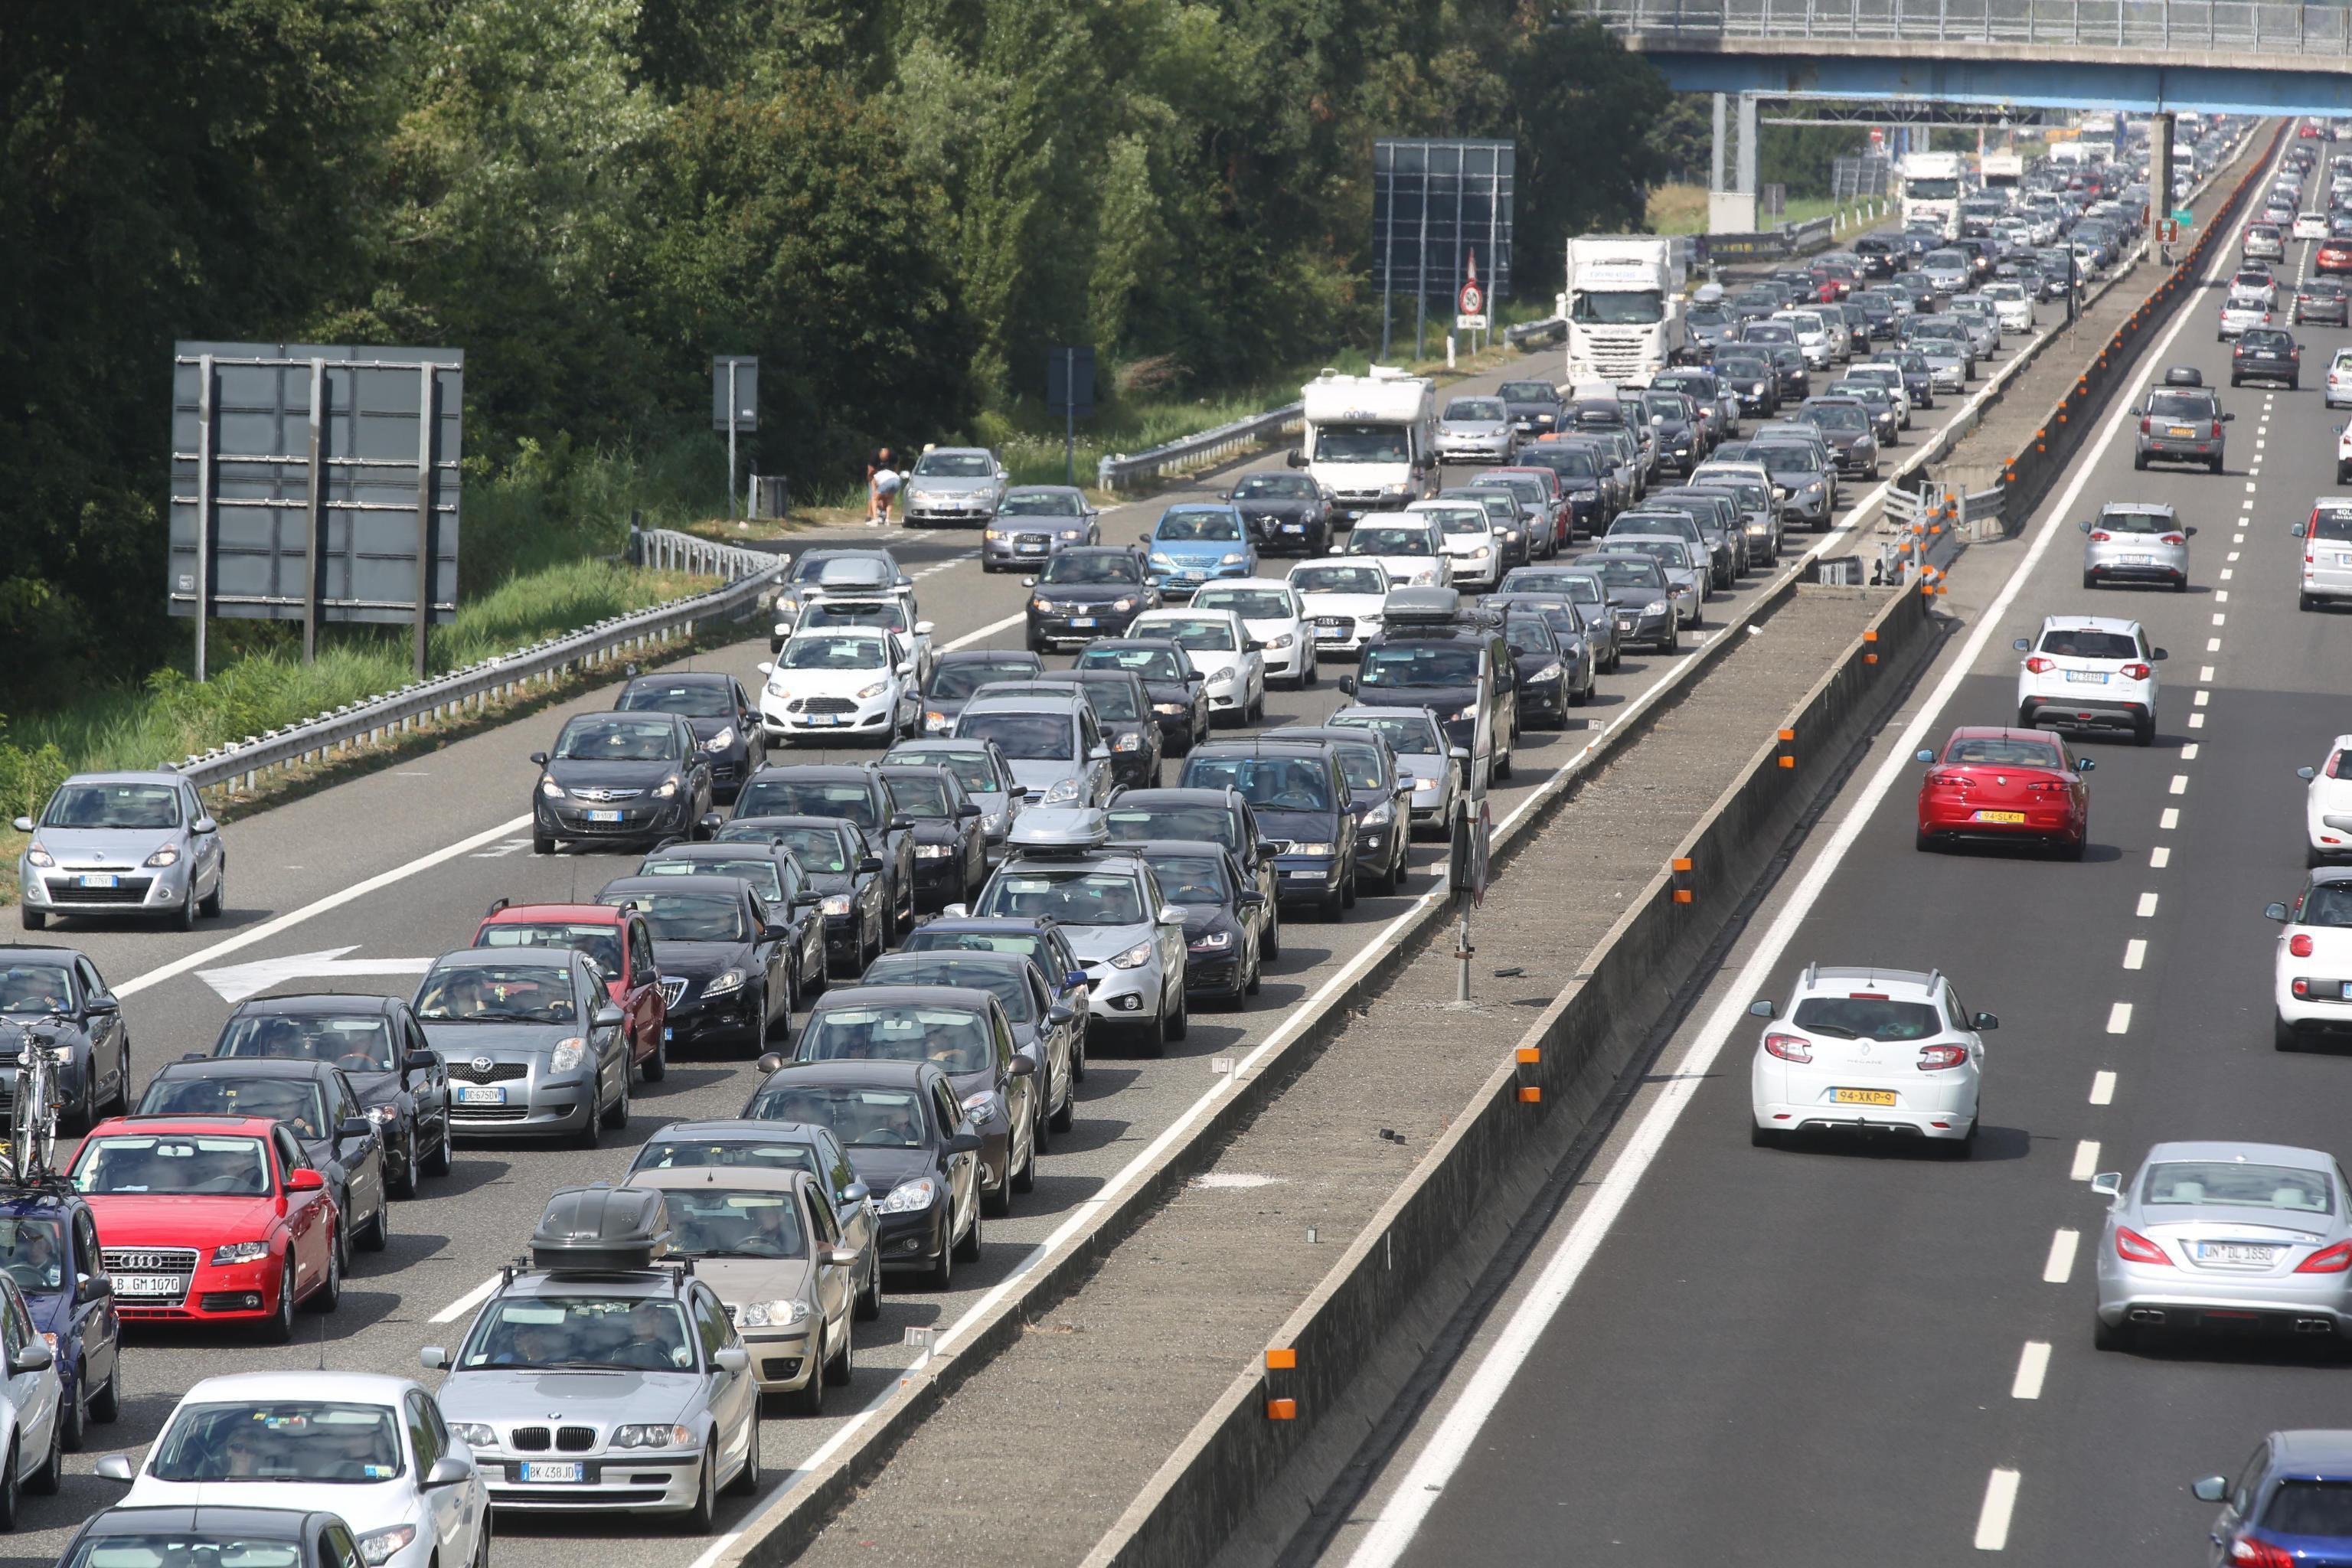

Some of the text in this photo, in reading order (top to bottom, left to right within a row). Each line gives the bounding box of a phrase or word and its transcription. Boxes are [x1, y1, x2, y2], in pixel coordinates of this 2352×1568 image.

[1984, 812, 2020, 822] 94-SLK-1
[1840, 1091, 1891, 1102] 94-XKP-9
[133, 1278, 147, 1290] GM
[151, 1279, 178, 1290] 1070
[531, 1467, 541, 1478] BK
[545, 1467, 573, 1478] 438JD
